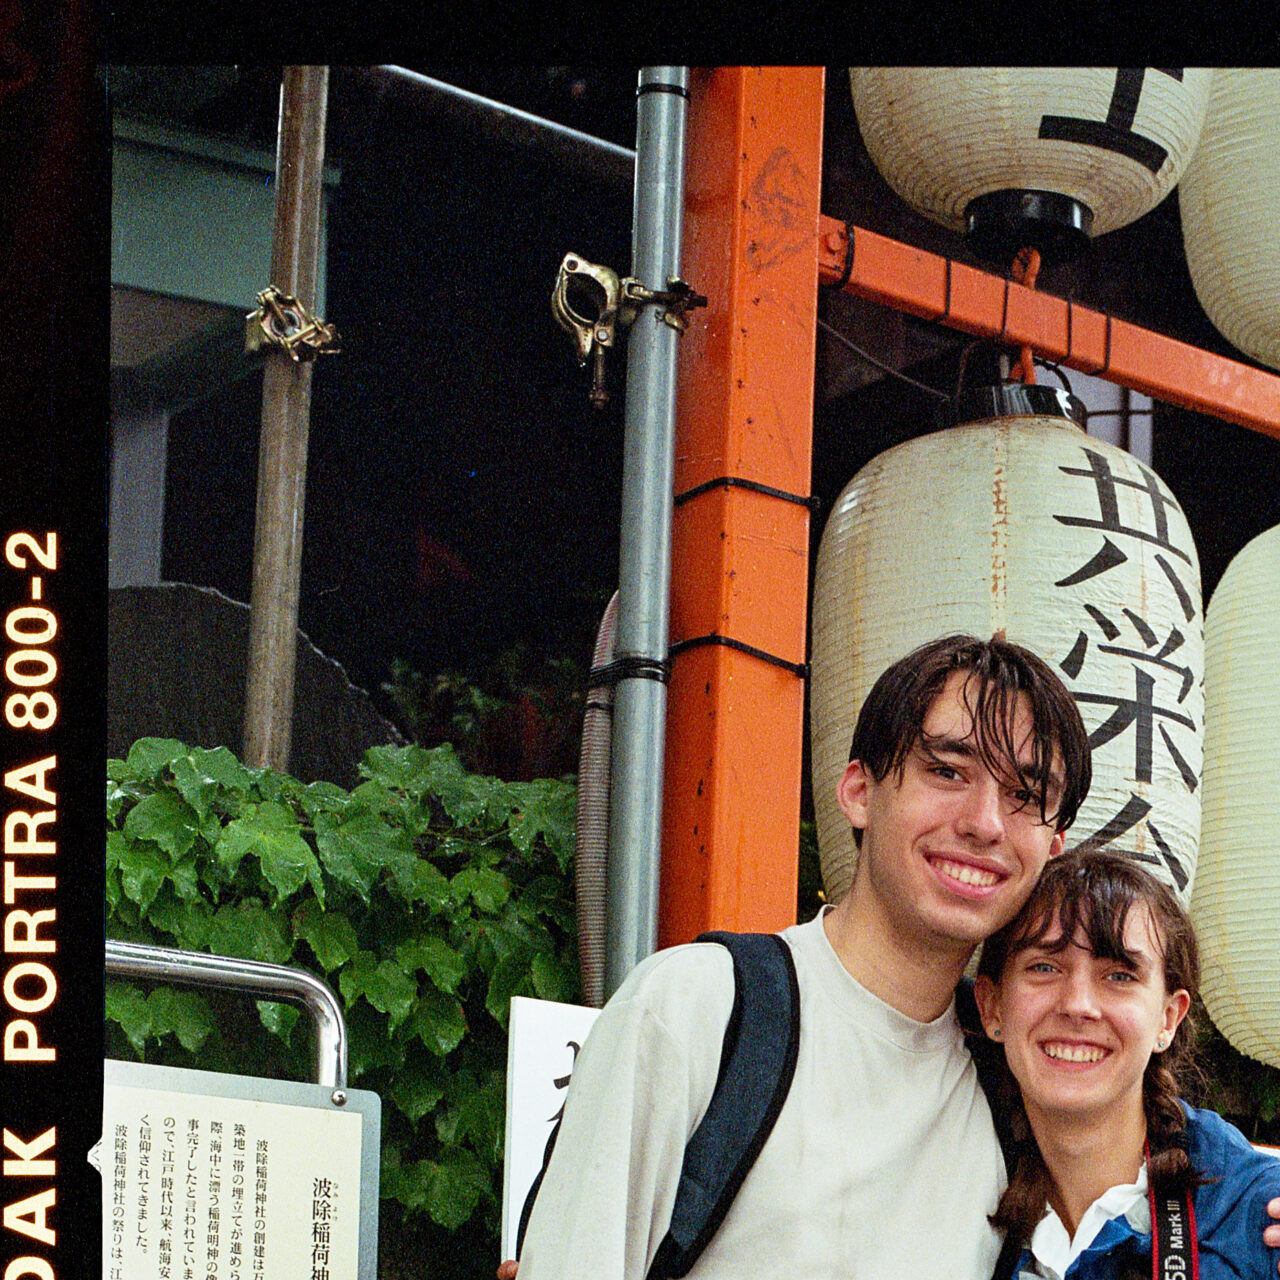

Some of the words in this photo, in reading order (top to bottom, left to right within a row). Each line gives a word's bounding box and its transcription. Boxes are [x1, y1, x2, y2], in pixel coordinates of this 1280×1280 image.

[5, 532, 57, 730] 800-2
[3, 755, 57, 1061] PORTRA
[1168, 1213, 1184, 1250] Mark
